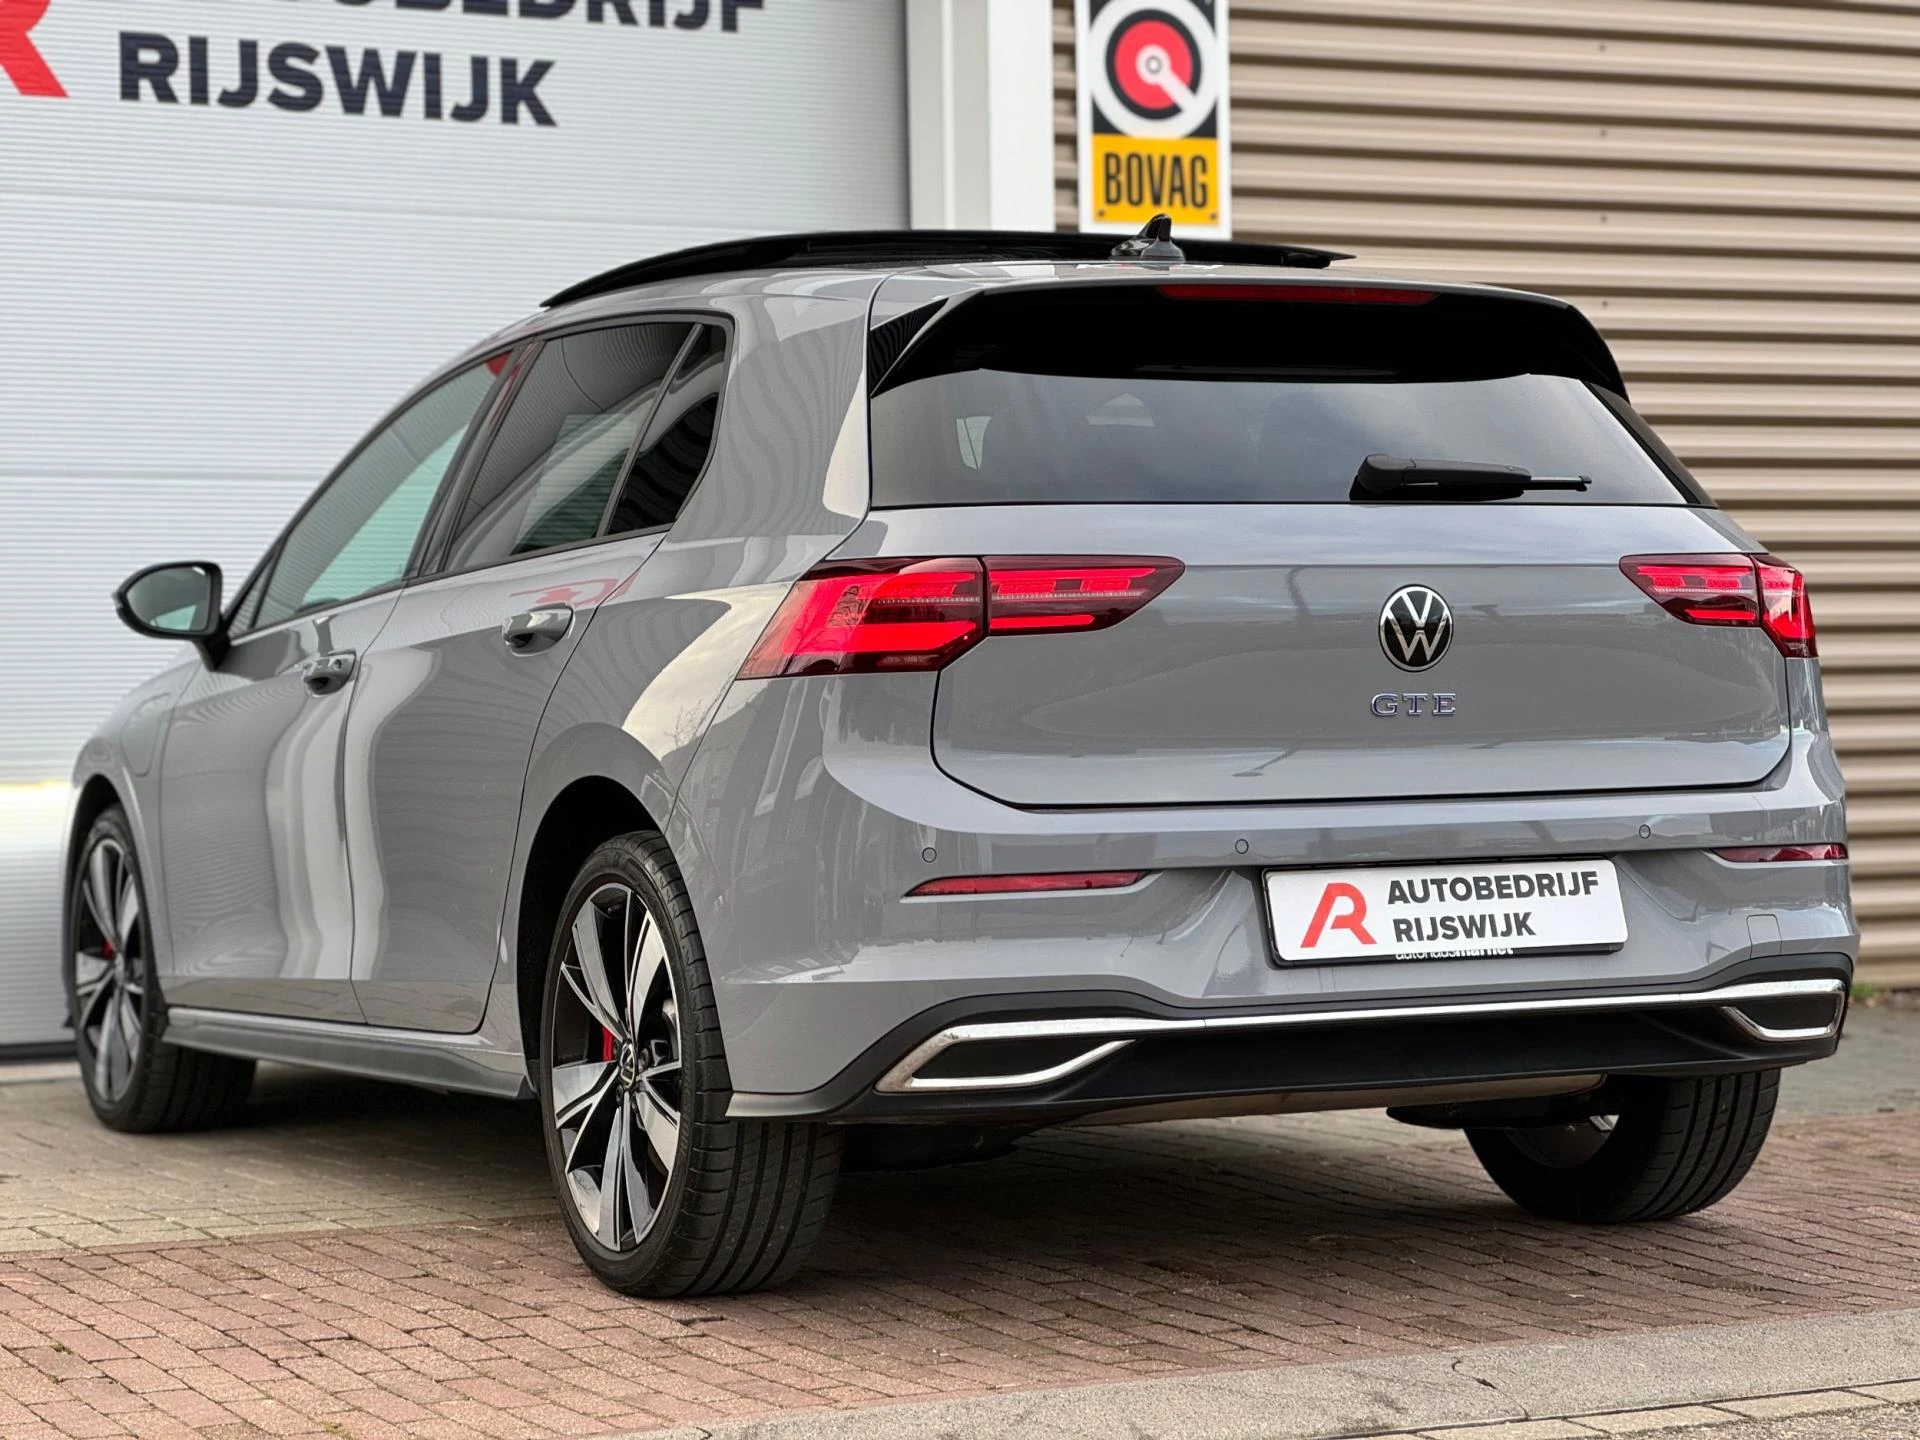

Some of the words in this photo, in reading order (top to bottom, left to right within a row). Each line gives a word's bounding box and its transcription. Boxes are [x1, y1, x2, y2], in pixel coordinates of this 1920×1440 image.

[119, 31, 557, 128] RIJSWIJK
[1104, 152, 1208, 209] BOVAG
[1371, 693, 1457, 718] GTE
[1388, 870, 1599, 905] AUTOBEDRIJF
[1392, 911, 1537, 943] RIJSWIJK
